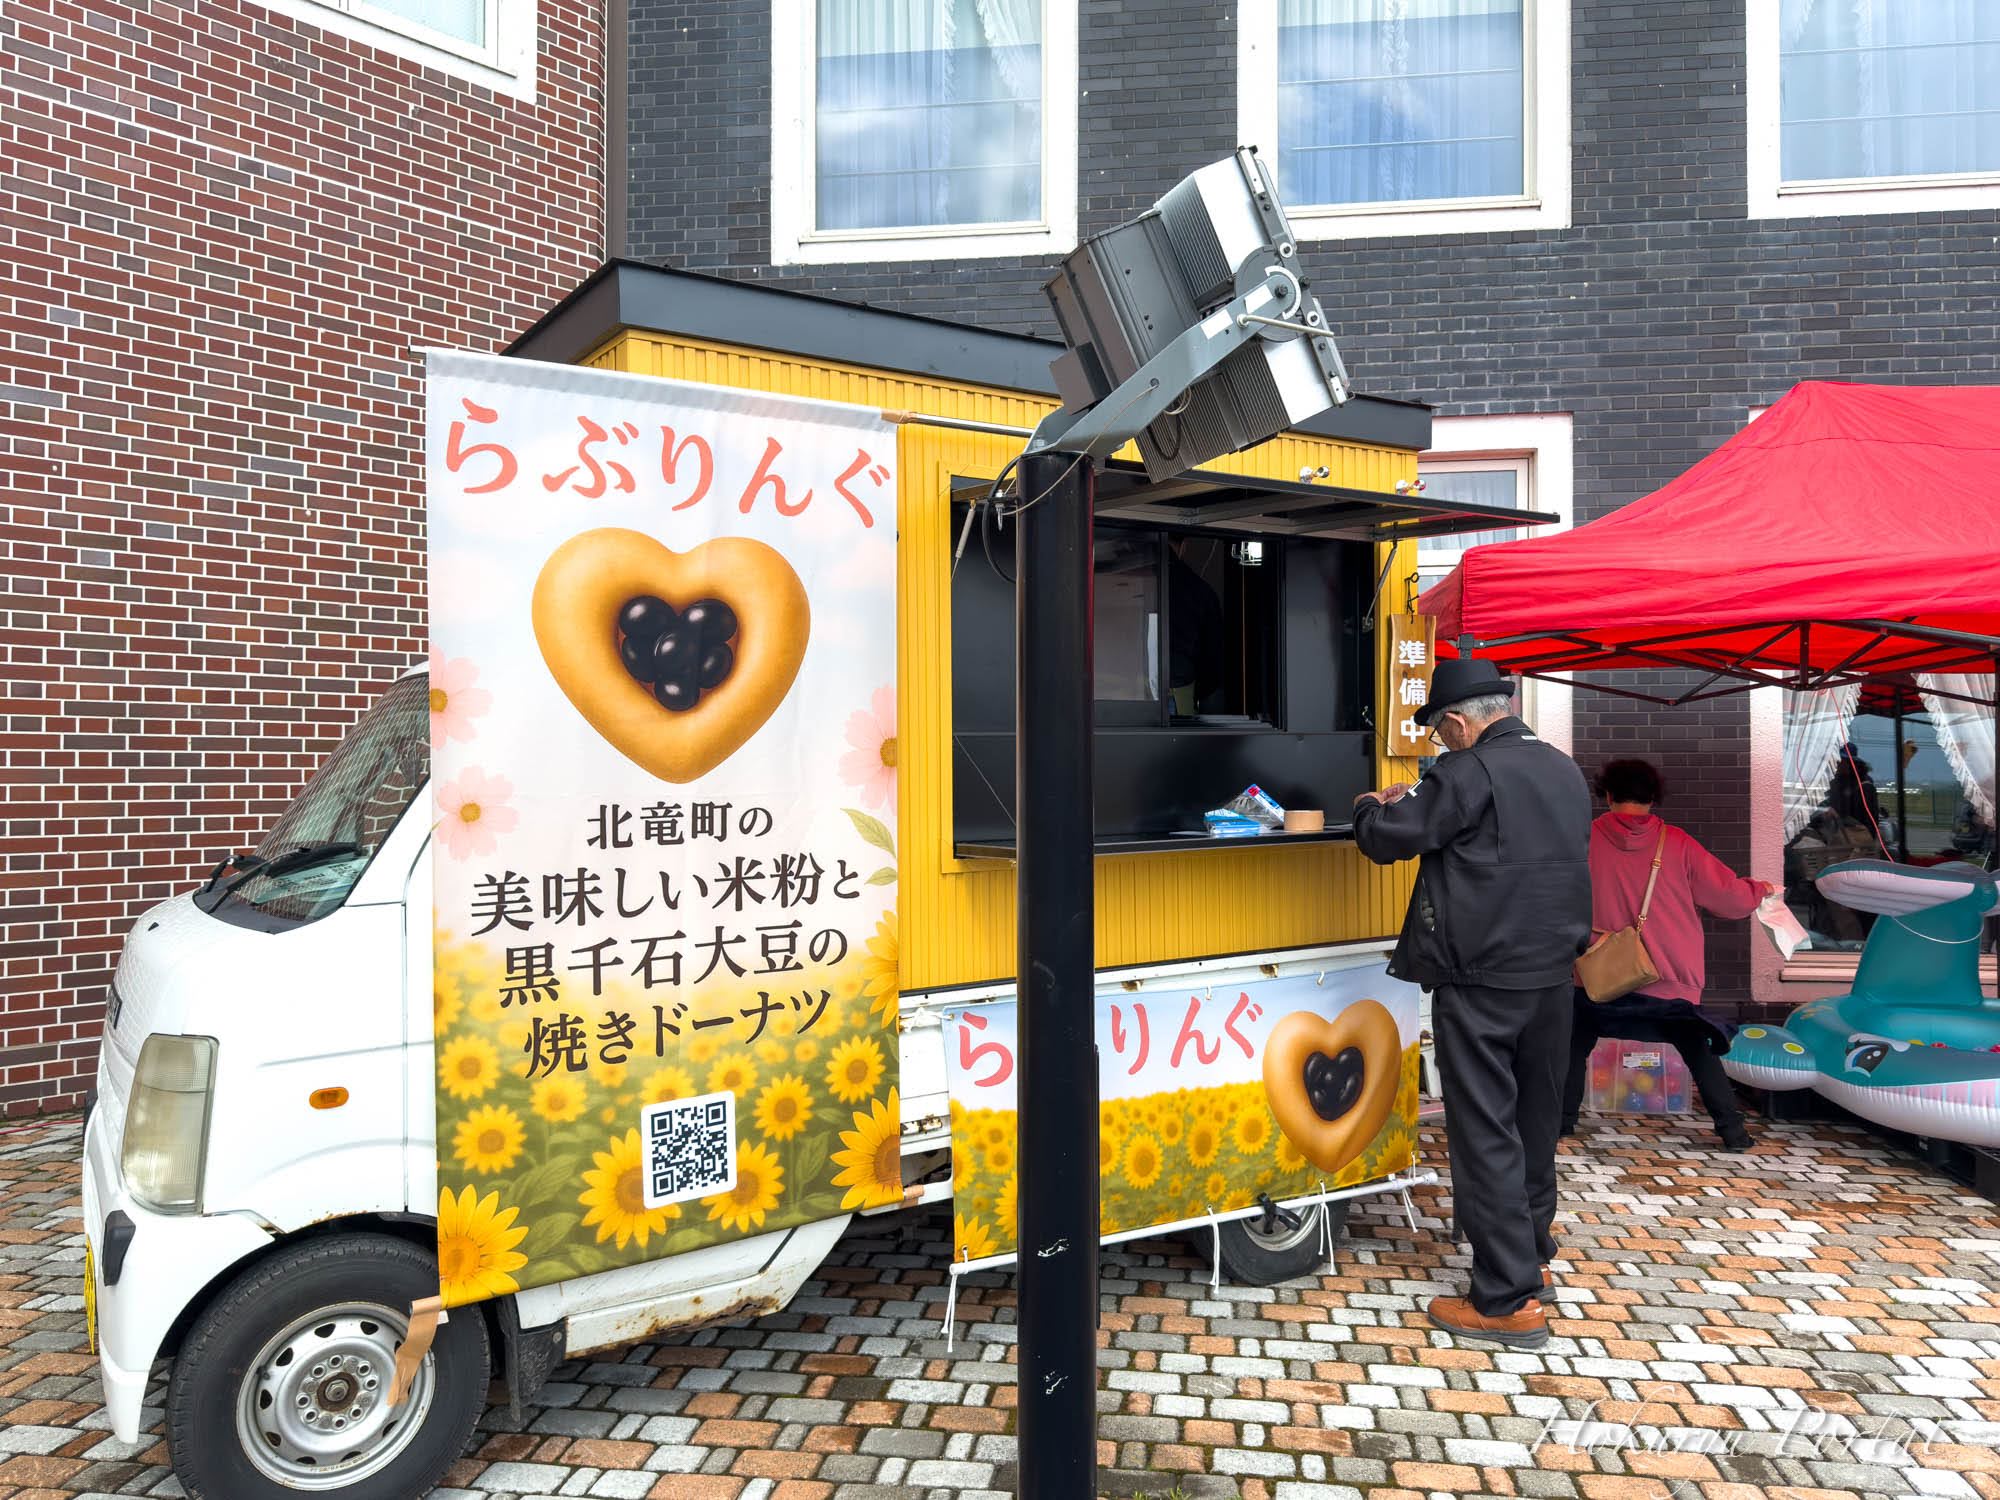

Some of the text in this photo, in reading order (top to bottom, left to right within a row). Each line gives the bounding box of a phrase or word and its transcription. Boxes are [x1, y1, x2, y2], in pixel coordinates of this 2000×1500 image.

[446, 397, 890, 528] らぶりんぐ
[1398, 639, 1426, 743] 準備中
[586, 801, 774, 850] 北竜町の
[471, 852, 861, 937] 美味しい米粉と
[499, 919, 848, 1009] 黒千石大豆の
[523, 989, 832, 1080] 焼きドーナツ
[958, 991, 1263, 1088] らりんぐ
